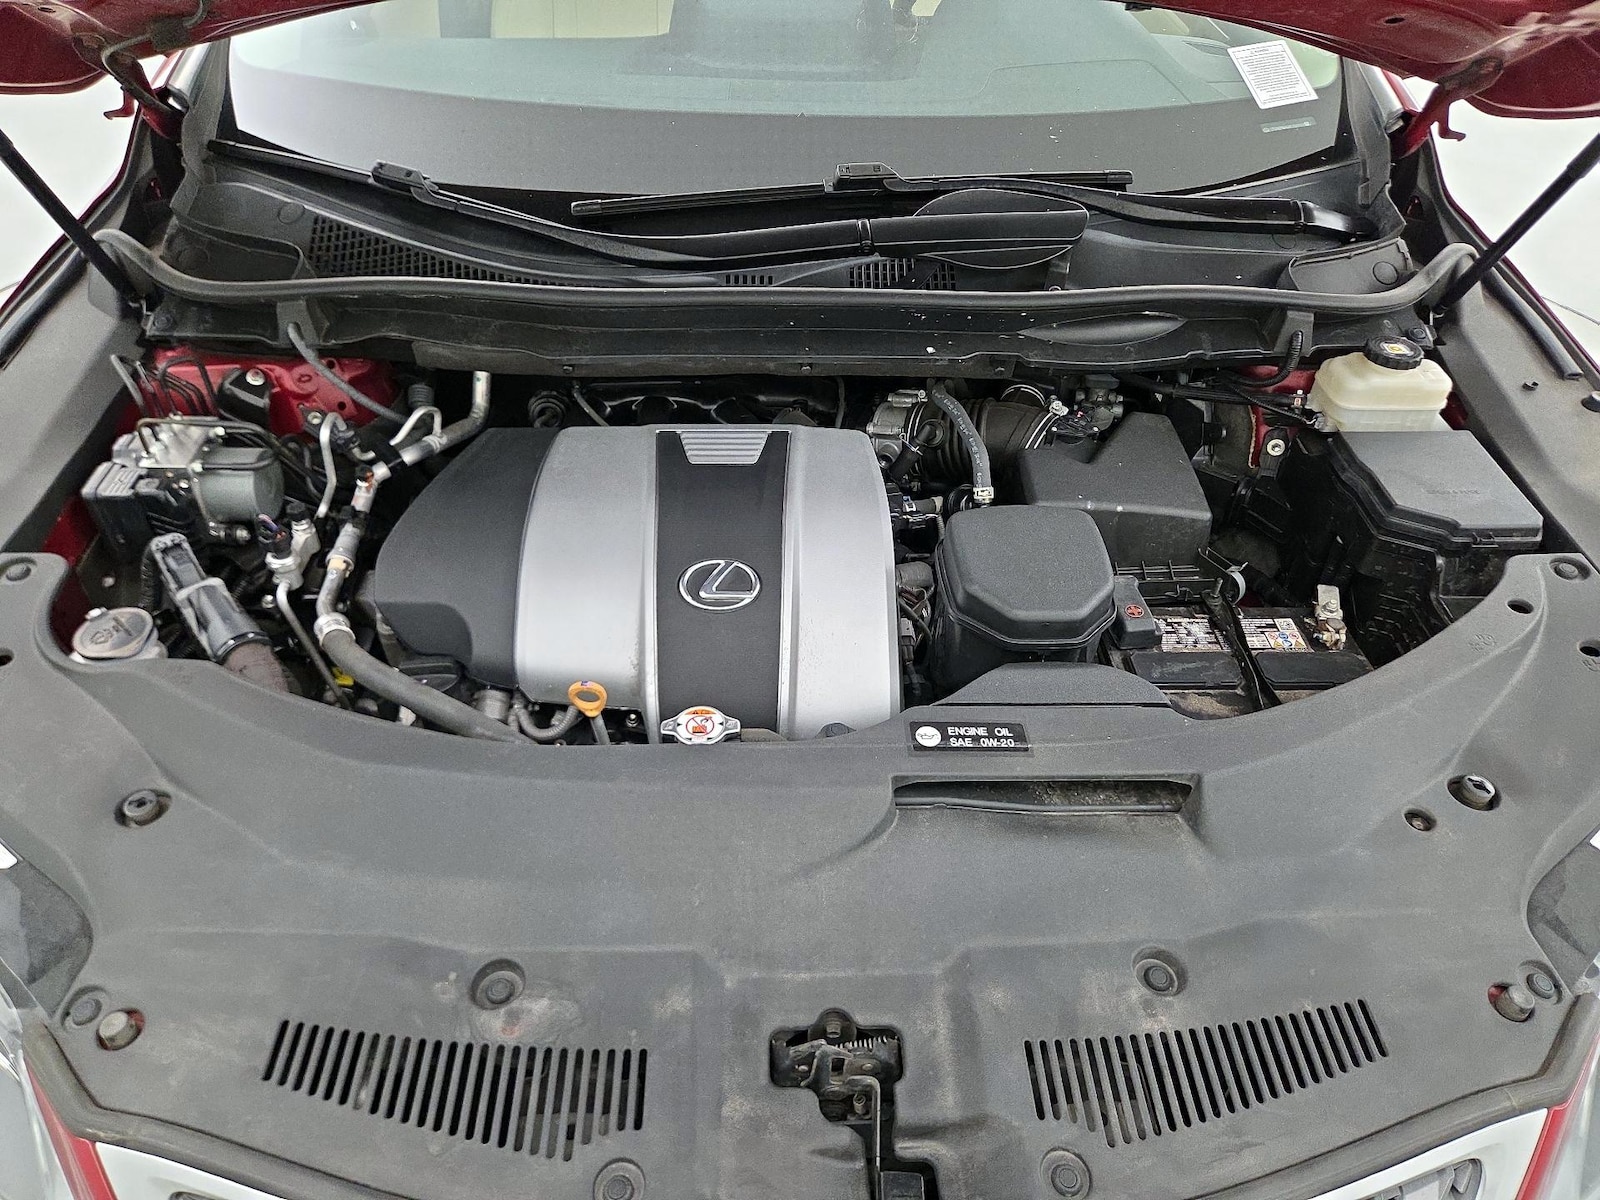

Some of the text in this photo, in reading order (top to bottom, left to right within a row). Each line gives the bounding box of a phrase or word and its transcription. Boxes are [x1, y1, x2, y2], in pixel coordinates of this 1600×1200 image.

[947, 726, 1014, 737] ENGINE OIL
[949, 738, 1015, 747] SAE 0W-20
